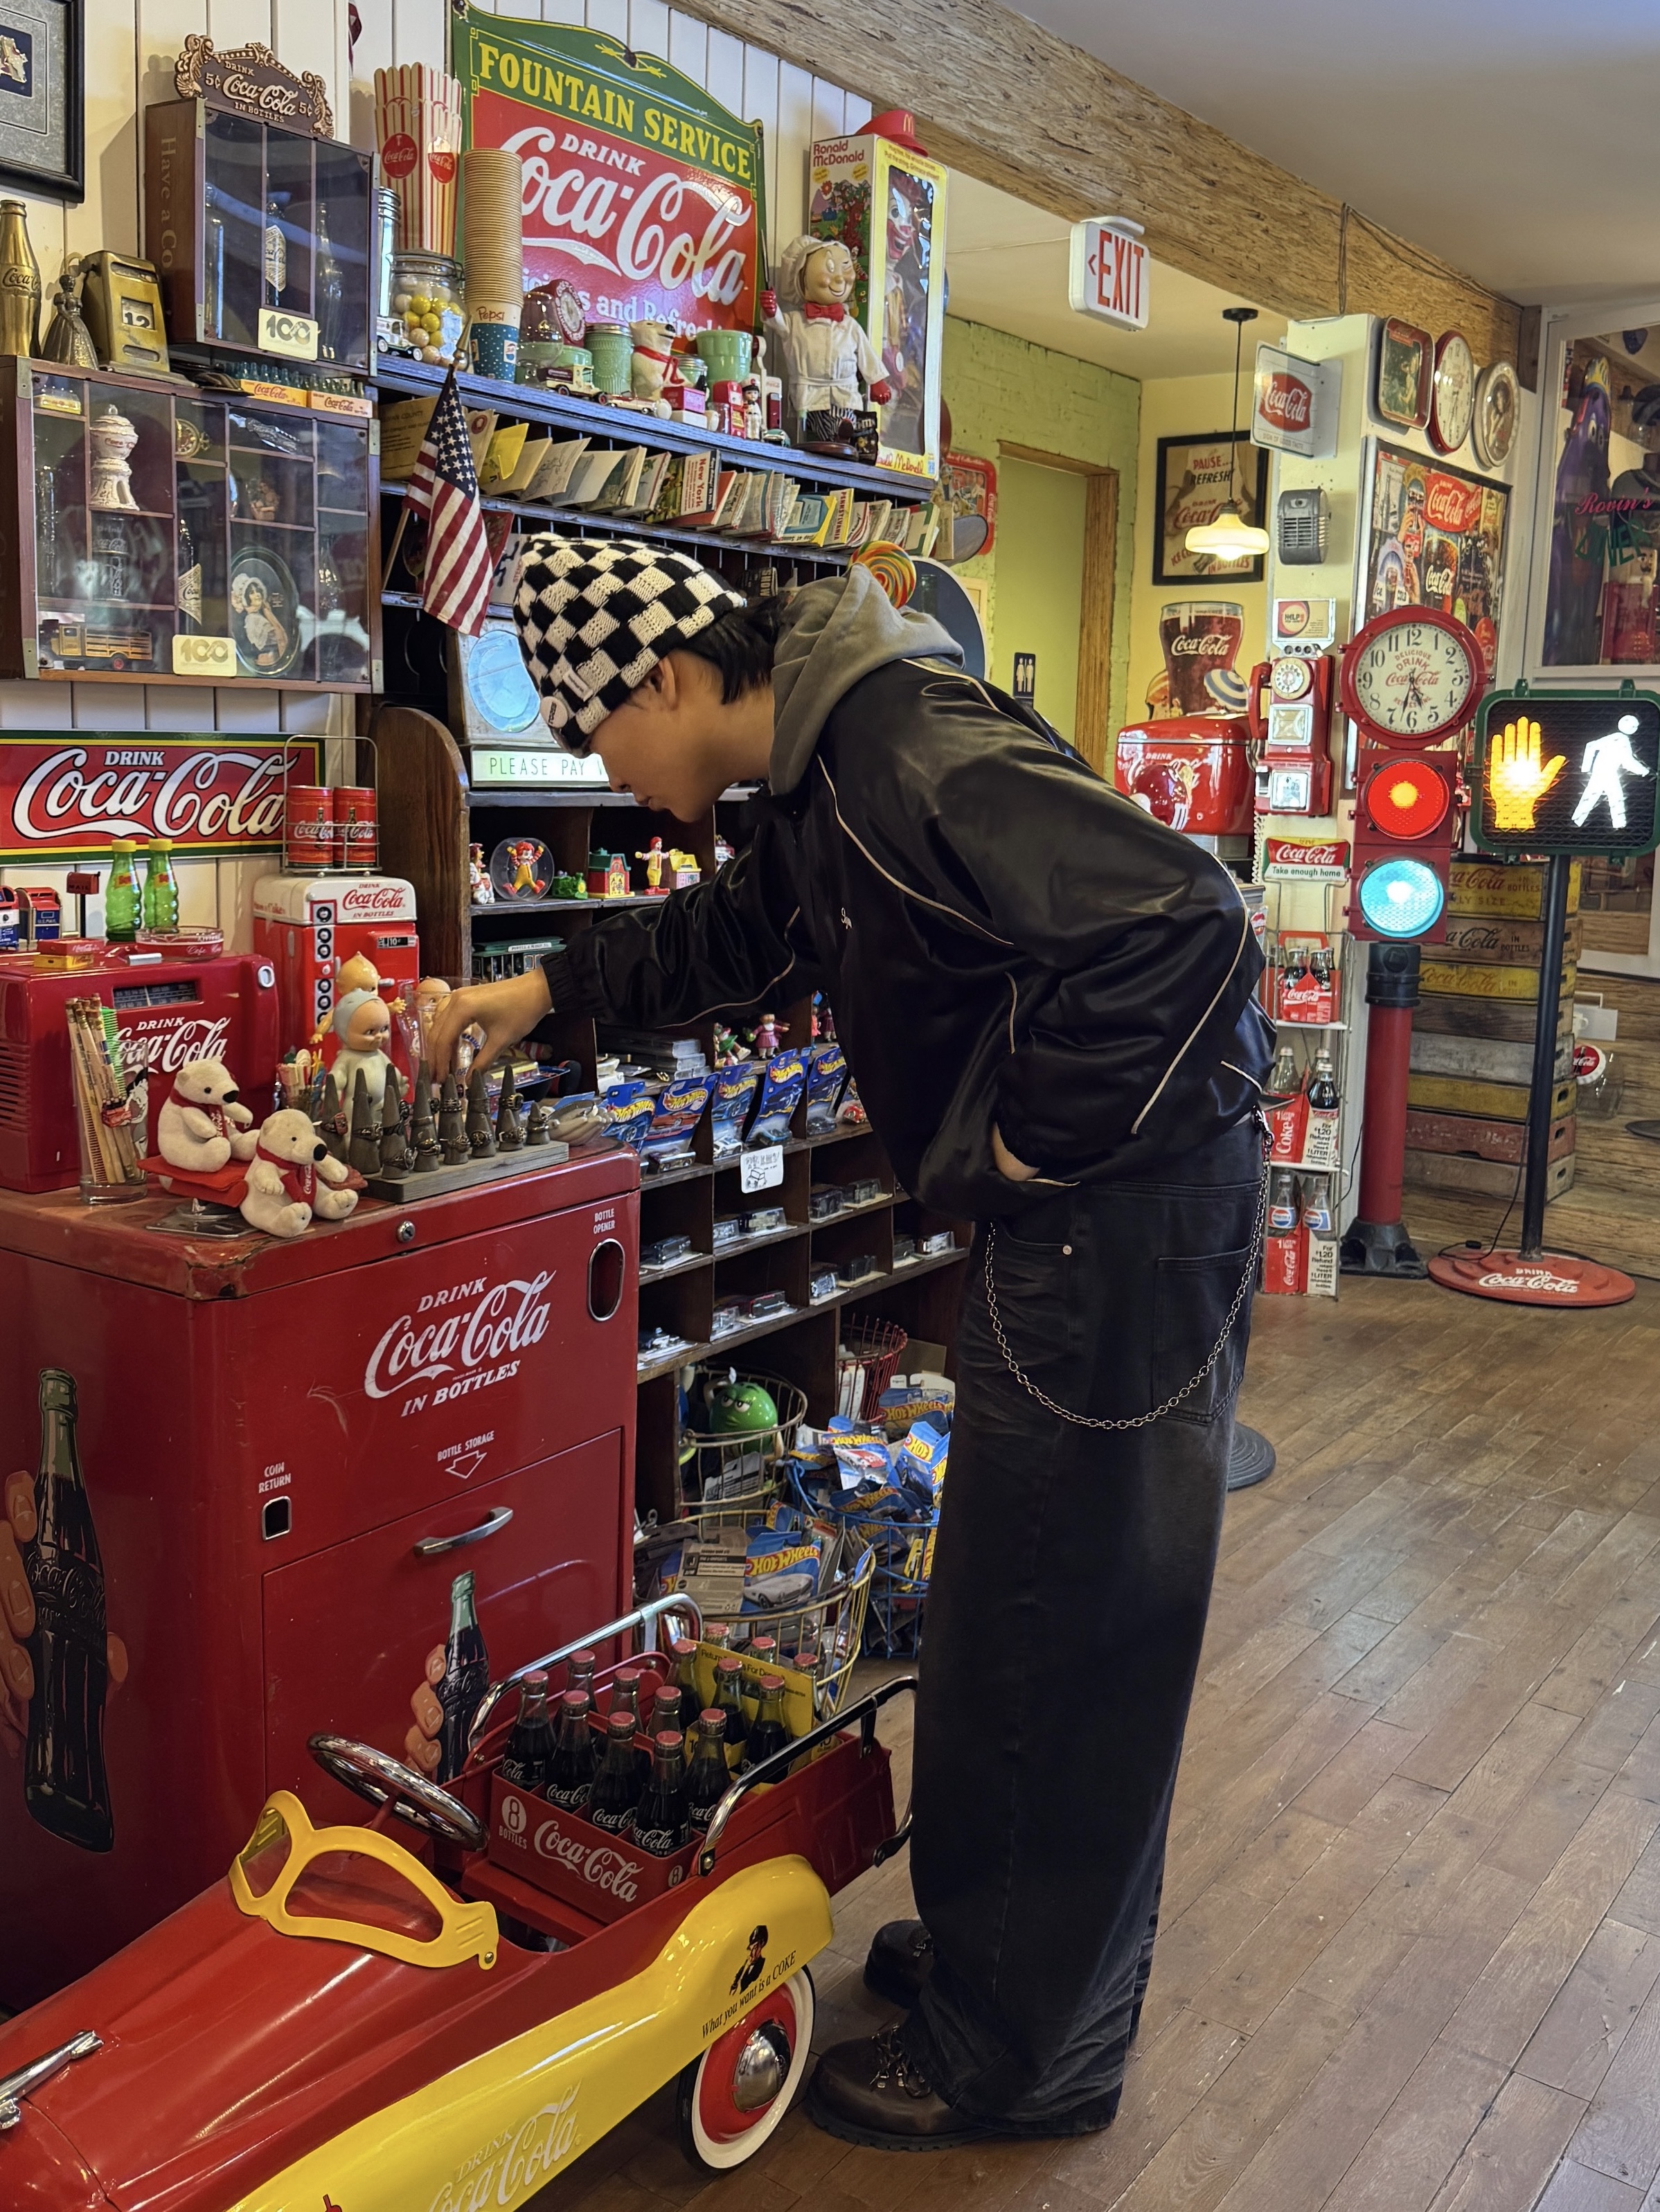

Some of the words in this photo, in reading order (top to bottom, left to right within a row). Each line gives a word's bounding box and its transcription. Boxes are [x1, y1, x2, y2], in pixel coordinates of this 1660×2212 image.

[224, 61, 255, 76] DRINK
[205, 73, 220, 89] 5¢
[222, 73, 298, 116] Coca-Cola
[235, 102, 246, 111] IN
[248, 106, 285, 123] BOTTLES
[479, 43, 634, 130] FOUNTAIN
[643, 107, 751, 179] SERVICE
[560, 134, 644, 177] DRINK
[813, 140, 848, 156] Ronald
[161, 137, 177, 199] Have
[813, 150, 864, 167] McDonald
[161, 210, 170, 222] a
[161, 229, 177, 268] Co
[1098, 229, 1143, 320] EXIT
[476, 306, 505, 321] Pepsi
[597, 296, 636, 323] and
[124, 312, 151, 329] 12
[1264, 381, 1308, 422] Coca-Cola
[698, 458, 706, 480] New
[695, 481, 705, 508] York
[1427, 483, 1465, 526] Coca-Cola
[1170, 634, 1233, 657] Coca-Cola
[1389, 634, 1399, 652] 11
[1407, 629, 1422, 646] 12
[1434, 632, 1438, 650] 1
[1371, 649, 1385, 668] 10
[1395, 649, 1431, 660] DELICIOUS
[1445, 647, 1456, 665] 2
[1396, 657, 1430, 672] DRINK
[1362, 672, 1373, 690] 9
[1370, 693, 1381, 711] 8
[1445, 690, 1457, 708] 4
[1387, 707, 1397, 725] 7
[1407, 711, 1417, 728] 6
[1427, 706, 1439, 723] 5
[105, 751, 165, 767] DRINK
[489, 756, 548, 776] PLEASE
[561, 759, 584, 775] PAY
[12, 747, 301, 840] Coca-Cola
[1276, 844, 1339, 864] Coca-Cola
[1290, 867, 1318, 877] enough
[1320, 867, 1341, 877] home
[1507, 884, 1540, 893] BOTTLES
[343, 887, 406, 910] Coca-Cola
[1501, 944, 1530, 952] BOTTLES
[1287, 988, 1319, 1001] Coca-Cola
[137, 1016, 186, 1031] DRINK
[1276, 1121, 1294, 1154] Coke
[594, 1208, 614, 1222] BOTTLE
[593, 1220, 616, 1235] OPENER
[1283, 1250, 1296, 1286] Coca-Cola
[1515, 1267, 1552, 1276] DRINK
[1479, 1272, 1580, 1294] Coca-Cola
[416, 1277, 488, 1313] DRINK
[364, 1269, 557, 1399] Coca-Cola
[401, 1399, 427, 1418] IN
[431, 1360, 521, 1407] BOTTLES
[886, 1406, 911, 1420] HOT
[437, 1441, 463, 1463] BOTTLE
[465, 1431, 495, 1453] STORAGE
[264, 1462, 285, 1478] COIN
[259, 1473, 291, 1494] RETURN
[752, 1557, 778, 1576] HOT
[701, 1649, 723, 1661] Return
[747, 1664, 759, 1674] For
[508, 1800, 520, 1829] 8
[499, 1825, 527, 1850] BOTTLES
[534, 1819, 645, 1902] Coca-Cola
[670, 1868, 681, 1886] 8
[702, 2013, 722, 2039] What
[723, 2002, 738, 2026] you
[740, 1985, 757, 2008] want
[759, 1978, 765, 1993] is
[766, 1975, 771, 1986] a
[773, 1950, 796, 1980] COKE
[456, 2125, 515, 2184] DRINK
